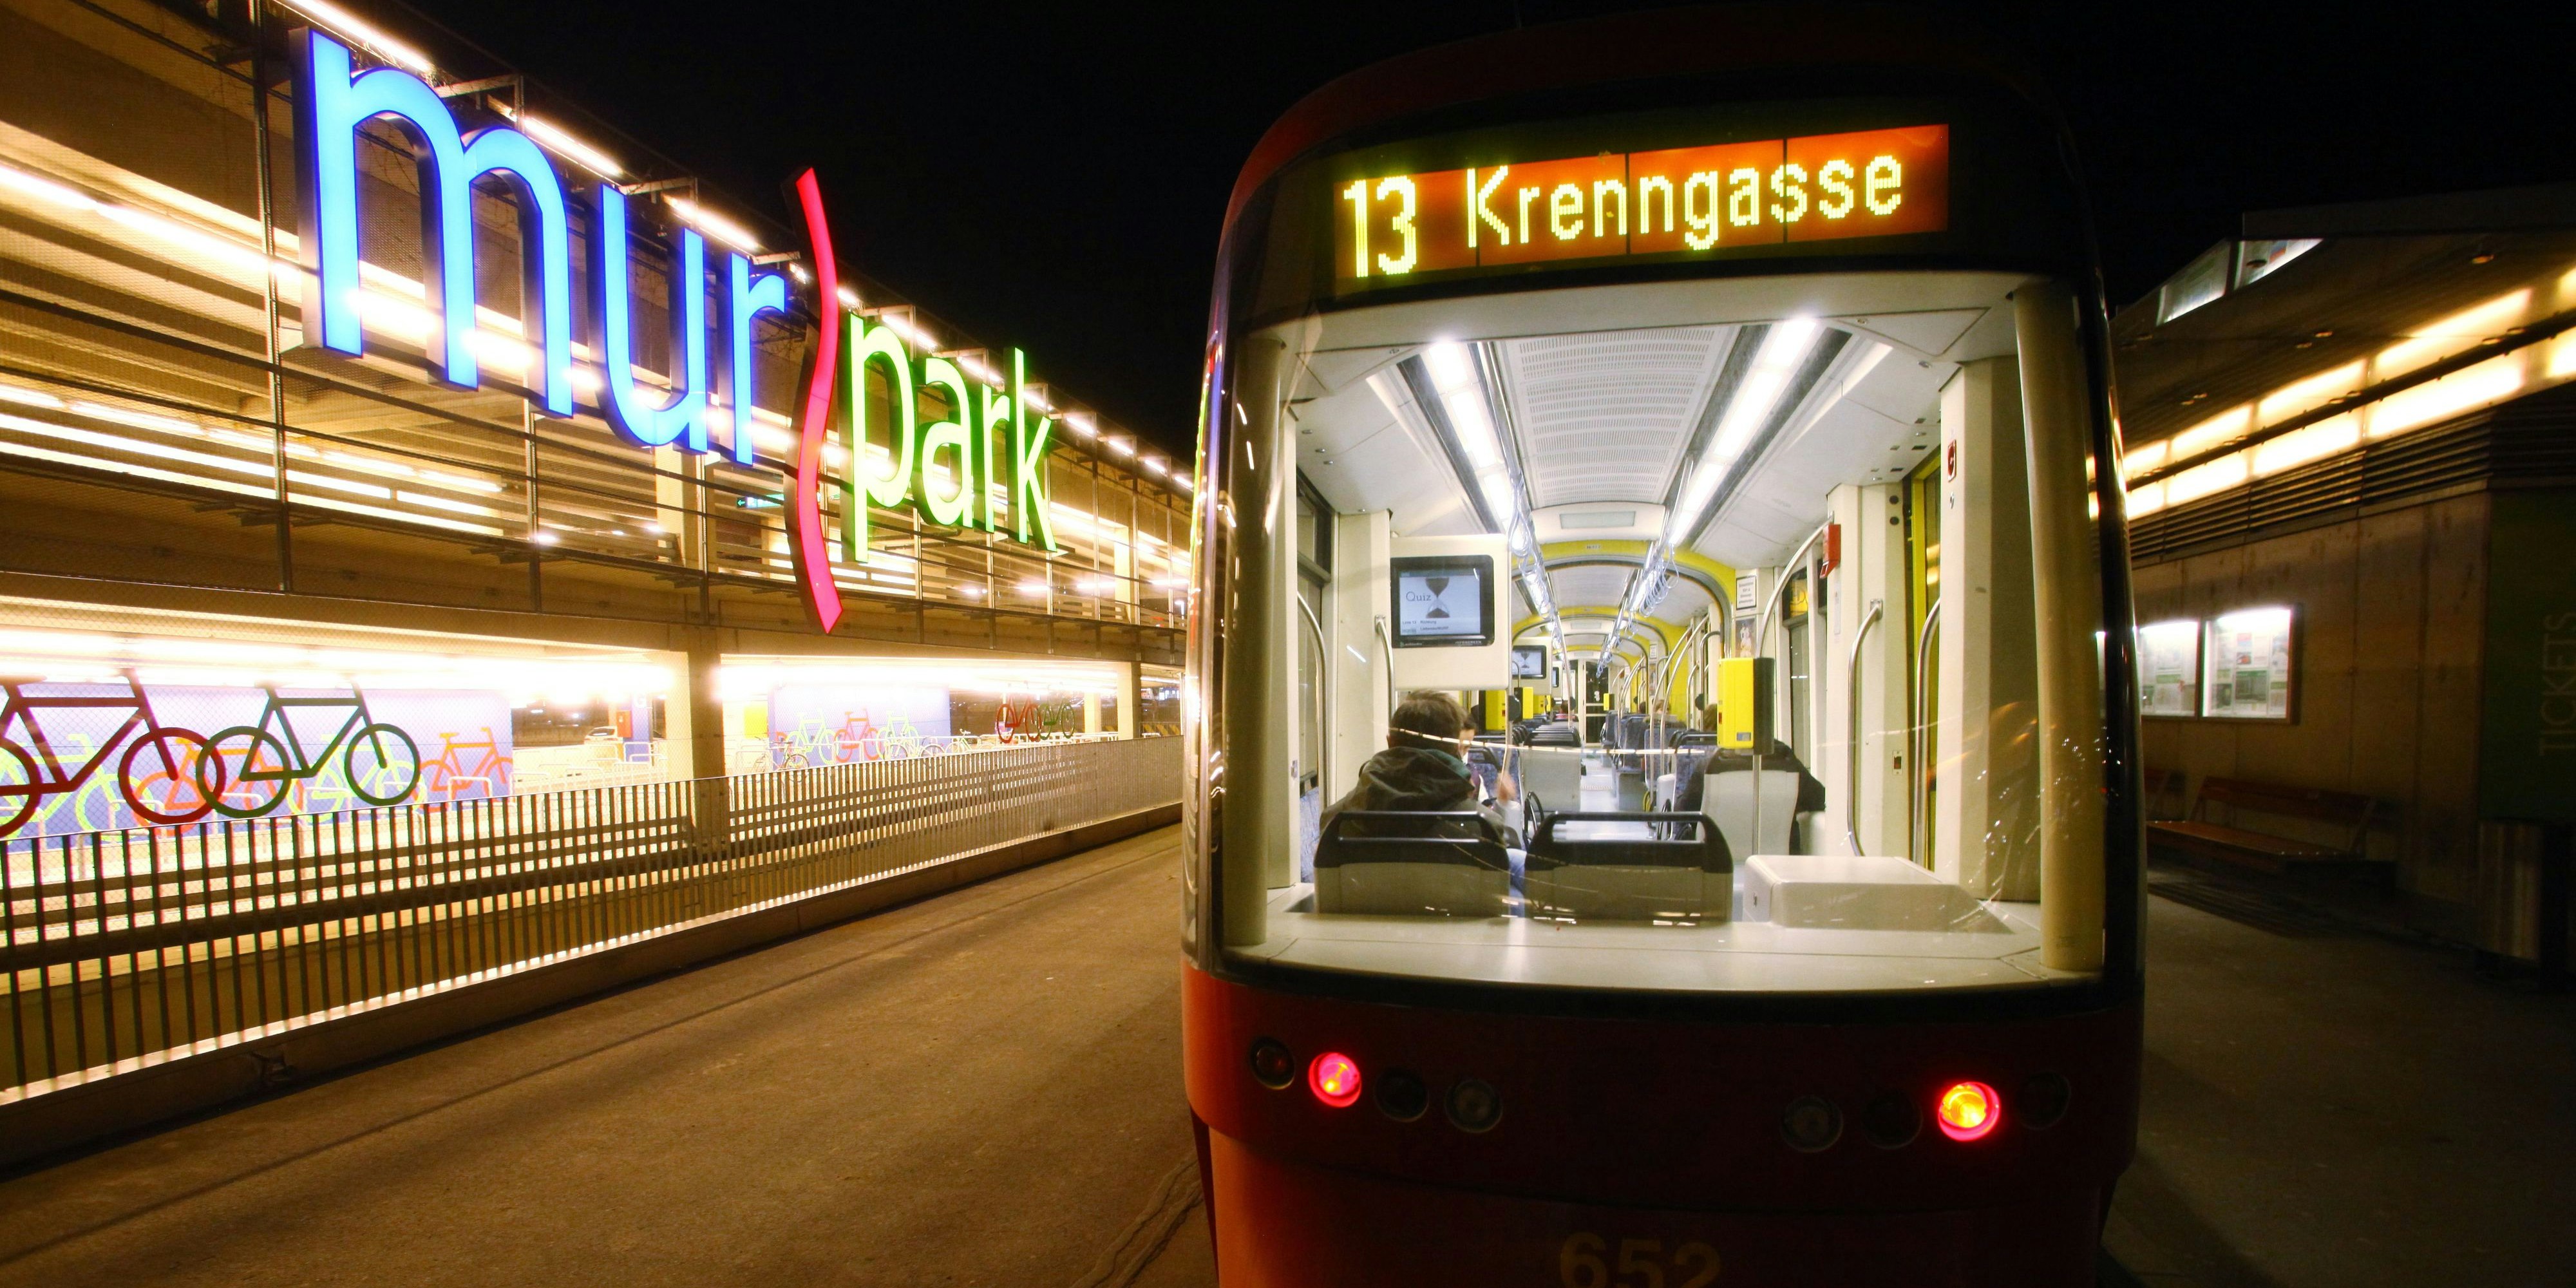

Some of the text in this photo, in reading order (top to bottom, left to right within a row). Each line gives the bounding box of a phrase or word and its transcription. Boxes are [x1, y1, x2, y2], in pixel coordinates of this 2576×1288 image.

[1343, 155, 1902, 278] 13 Krenngasse
[307, 27, 1057, 564] mur park
[1406, 591, 1431, 601] Quiz
[2540, 612, 2576, 756] TICKETS
[1560, 1231, 1720, 1288] 652
